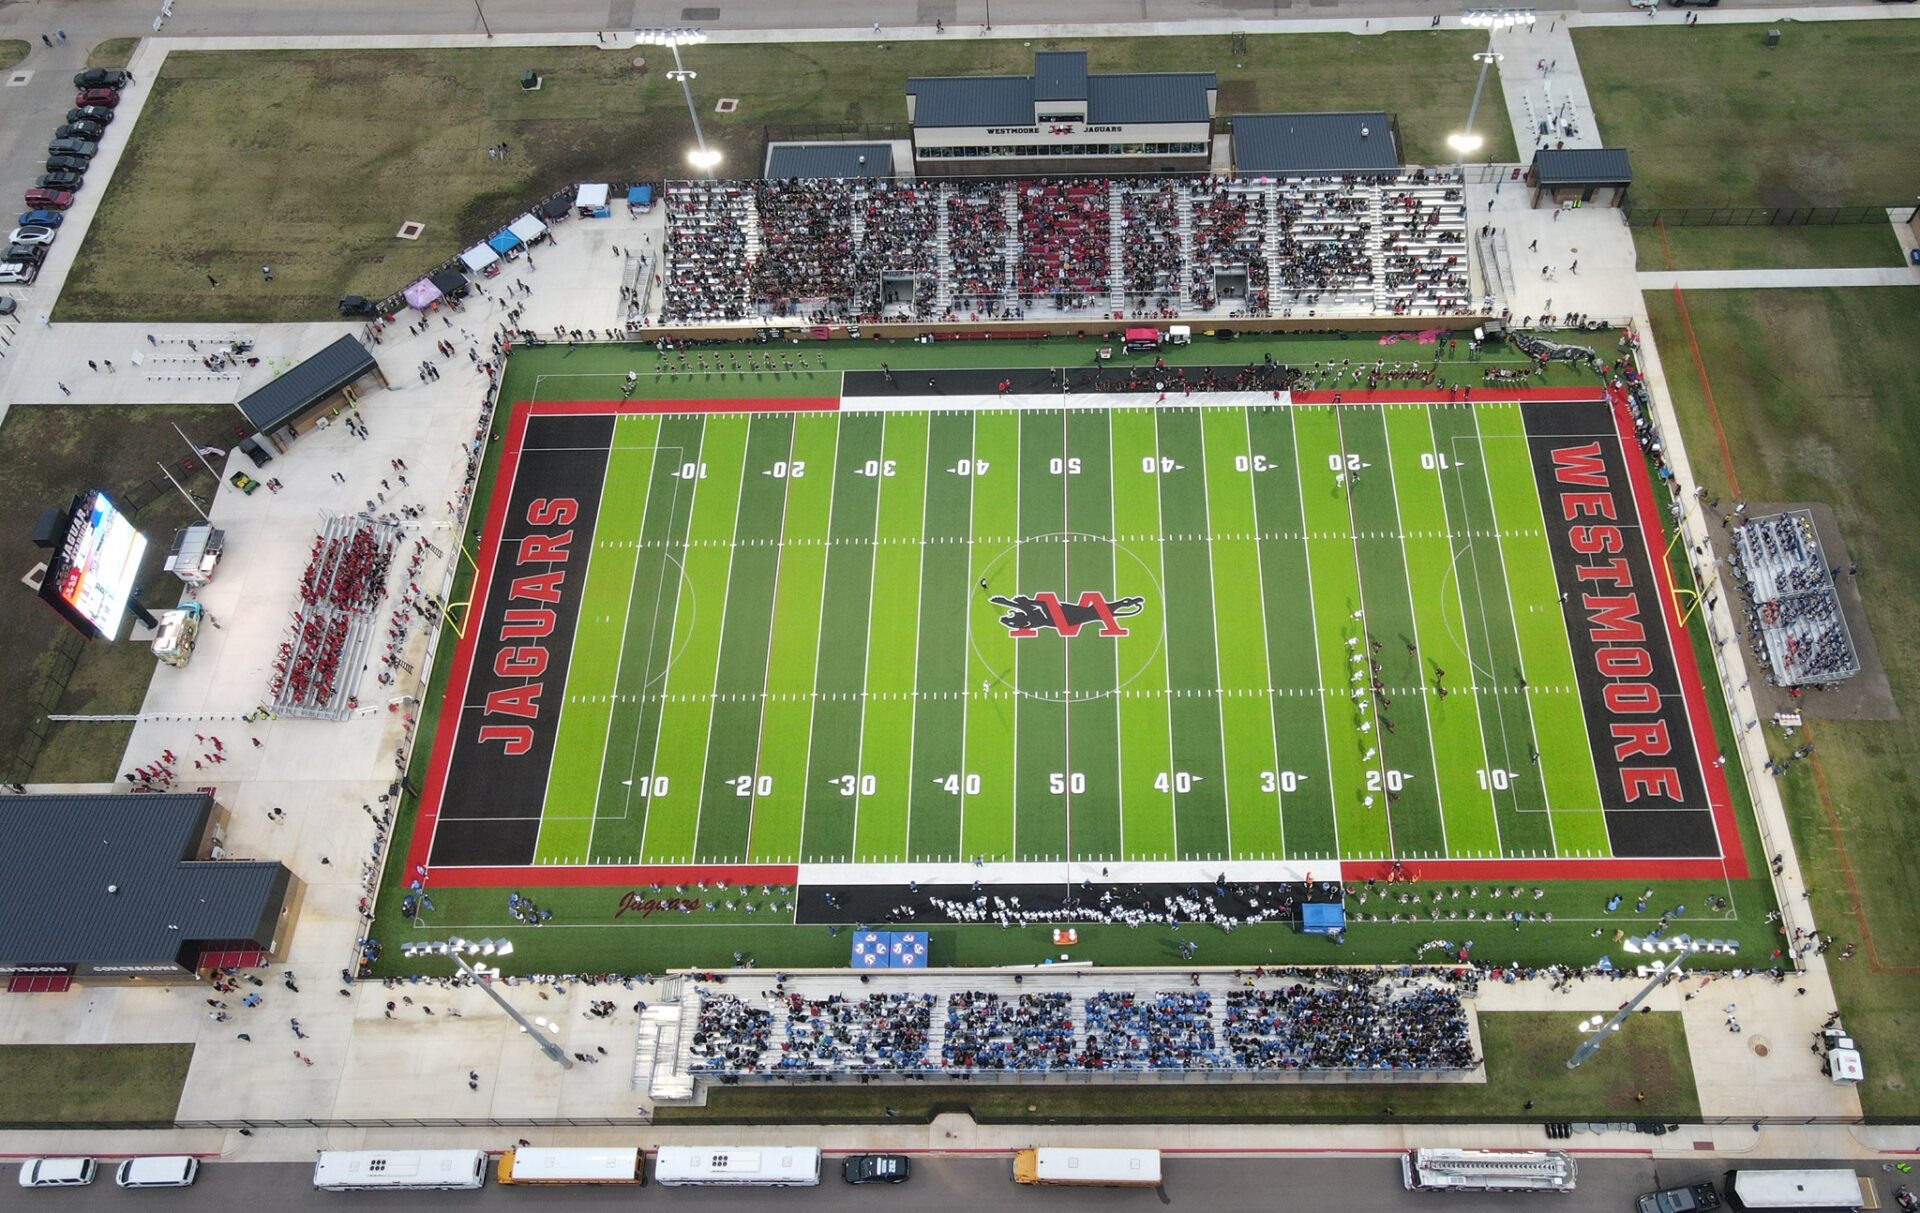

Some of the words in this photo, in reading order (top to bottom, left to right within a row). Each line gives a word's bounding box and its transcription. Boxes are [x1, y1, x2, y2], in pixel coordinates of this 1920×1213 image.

[987, 127, 1040, 135] WESTMOORE
[1367, 367, 1435, 386] Jaguar
[681, 462, 707, 480] 10
[772, 461, 806, 478] 20
[864, 460, 897, 477] 30
[957, 459, 990, 476] 40
[1049, 457, 1081, 475] 50
[1141, 456, 1175, 474] 40
[1234, 455, 1267, 473] 30
[1328, 454, 1361, 471] 20
[1420, 452, 1449, 470] 10
[62, 508, 87, 564] JAGUAR
[477, 497, 579, 756] JAGUARS
[1550, 440, 1684, 803] WESTMOORE
[640, 776, 669, 797] 10
[736, 775, 773, 797] 20
[840, 774, 877, 796] 30
[943, 773, 982, 795] 40
[1049, 772, 1086, 795] 50
[1153, 771, 1191, 794] 40
[1260, 771, 1297, 793] 30
[1365, 770, 1403, 792] 20
[1476, 769, 1508, 790] 10
[614, 891, 701, 919] Jaguars
